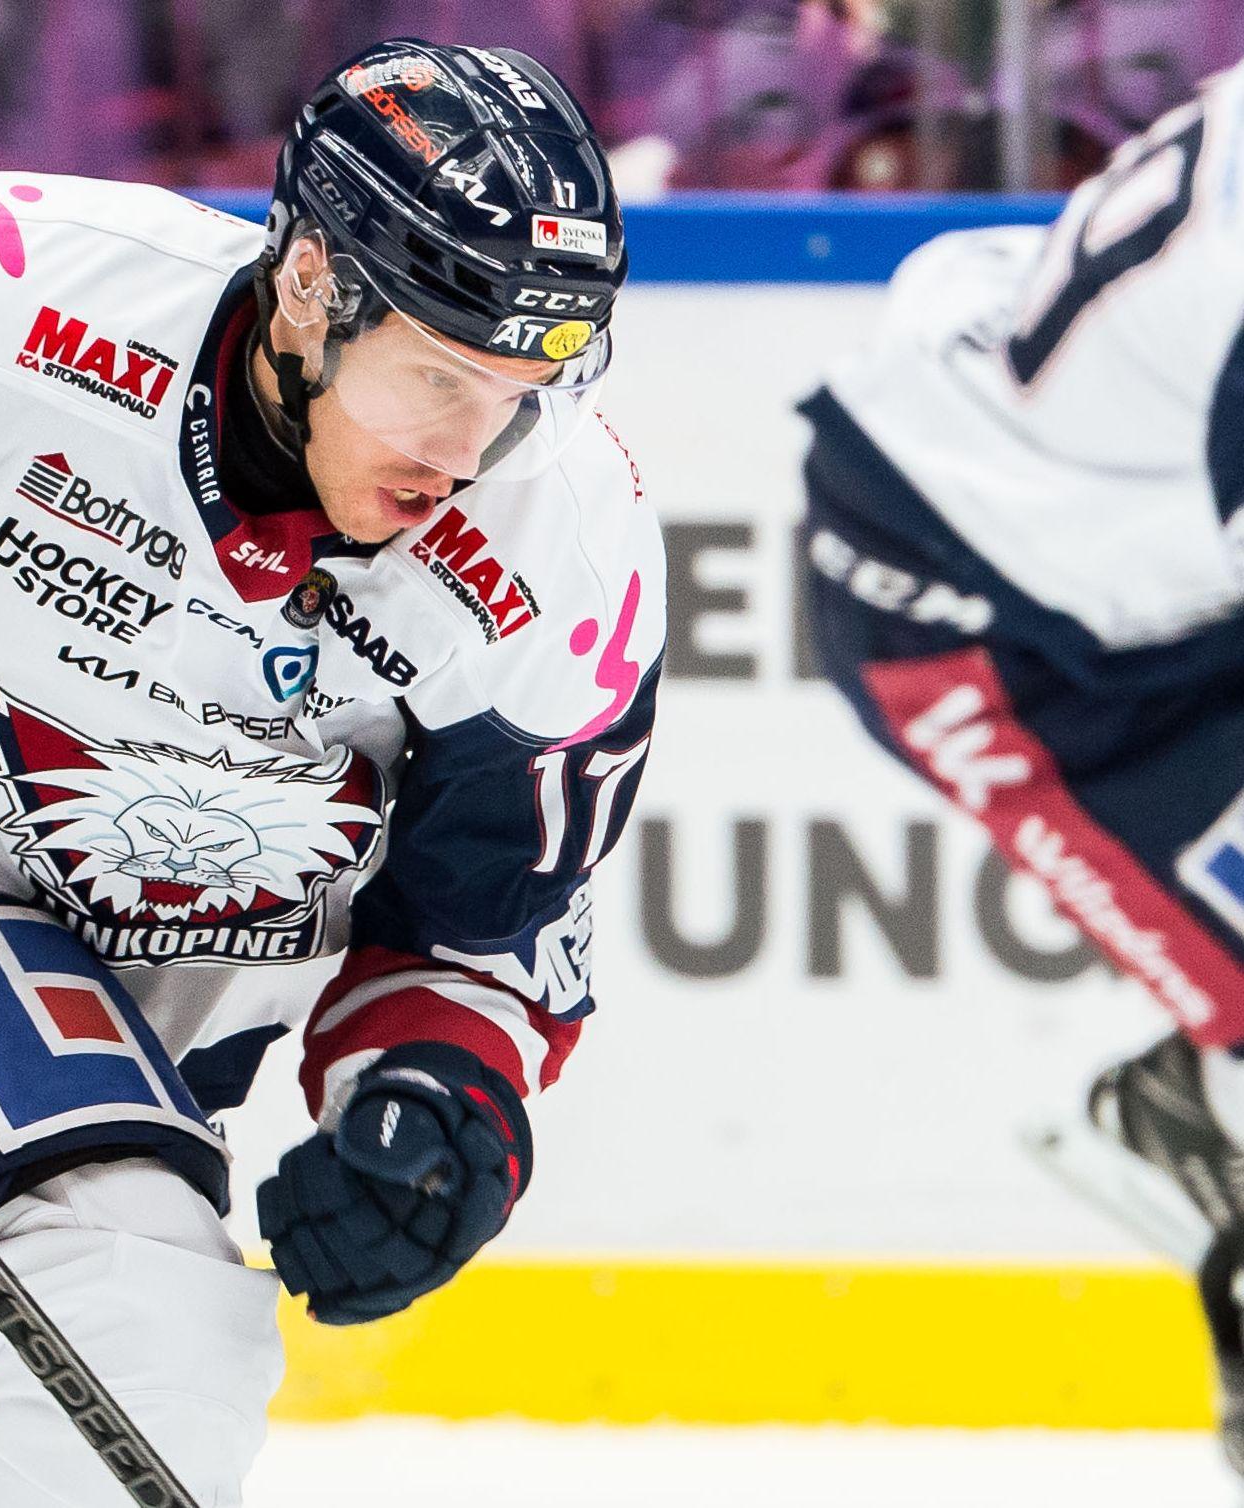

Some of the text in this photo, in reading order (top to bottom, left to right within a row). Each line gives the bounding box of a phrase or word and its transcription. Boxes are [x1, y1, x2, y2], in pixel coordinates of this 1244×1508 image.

[562, 227, 603, 241] SVENSKA
[562, 239, 585, 250] SPEL
[492, 321, 547, 351] AT
[514, 288, 602, 311] CCM
[15, 352, 157, 420] ICA STORMARKNAD
[23, 306, 175, 406] MAXI
[190, 418, 221, 505] CENTRIA
[59, 476, 188, 580] Botrygg
[229, 541, 290, 574] SHL
[13, 566, 142, 645] STORE
[421, 506, 533, 639] MAXI
[429, 560, 499, 645] STORMARKN
[187, 598, 264, 650] CCM
[325, 593, 419, 688] SAAB
[530, 737, 650, 872] 17
[56, 904, 302, 958] INKÖPING
